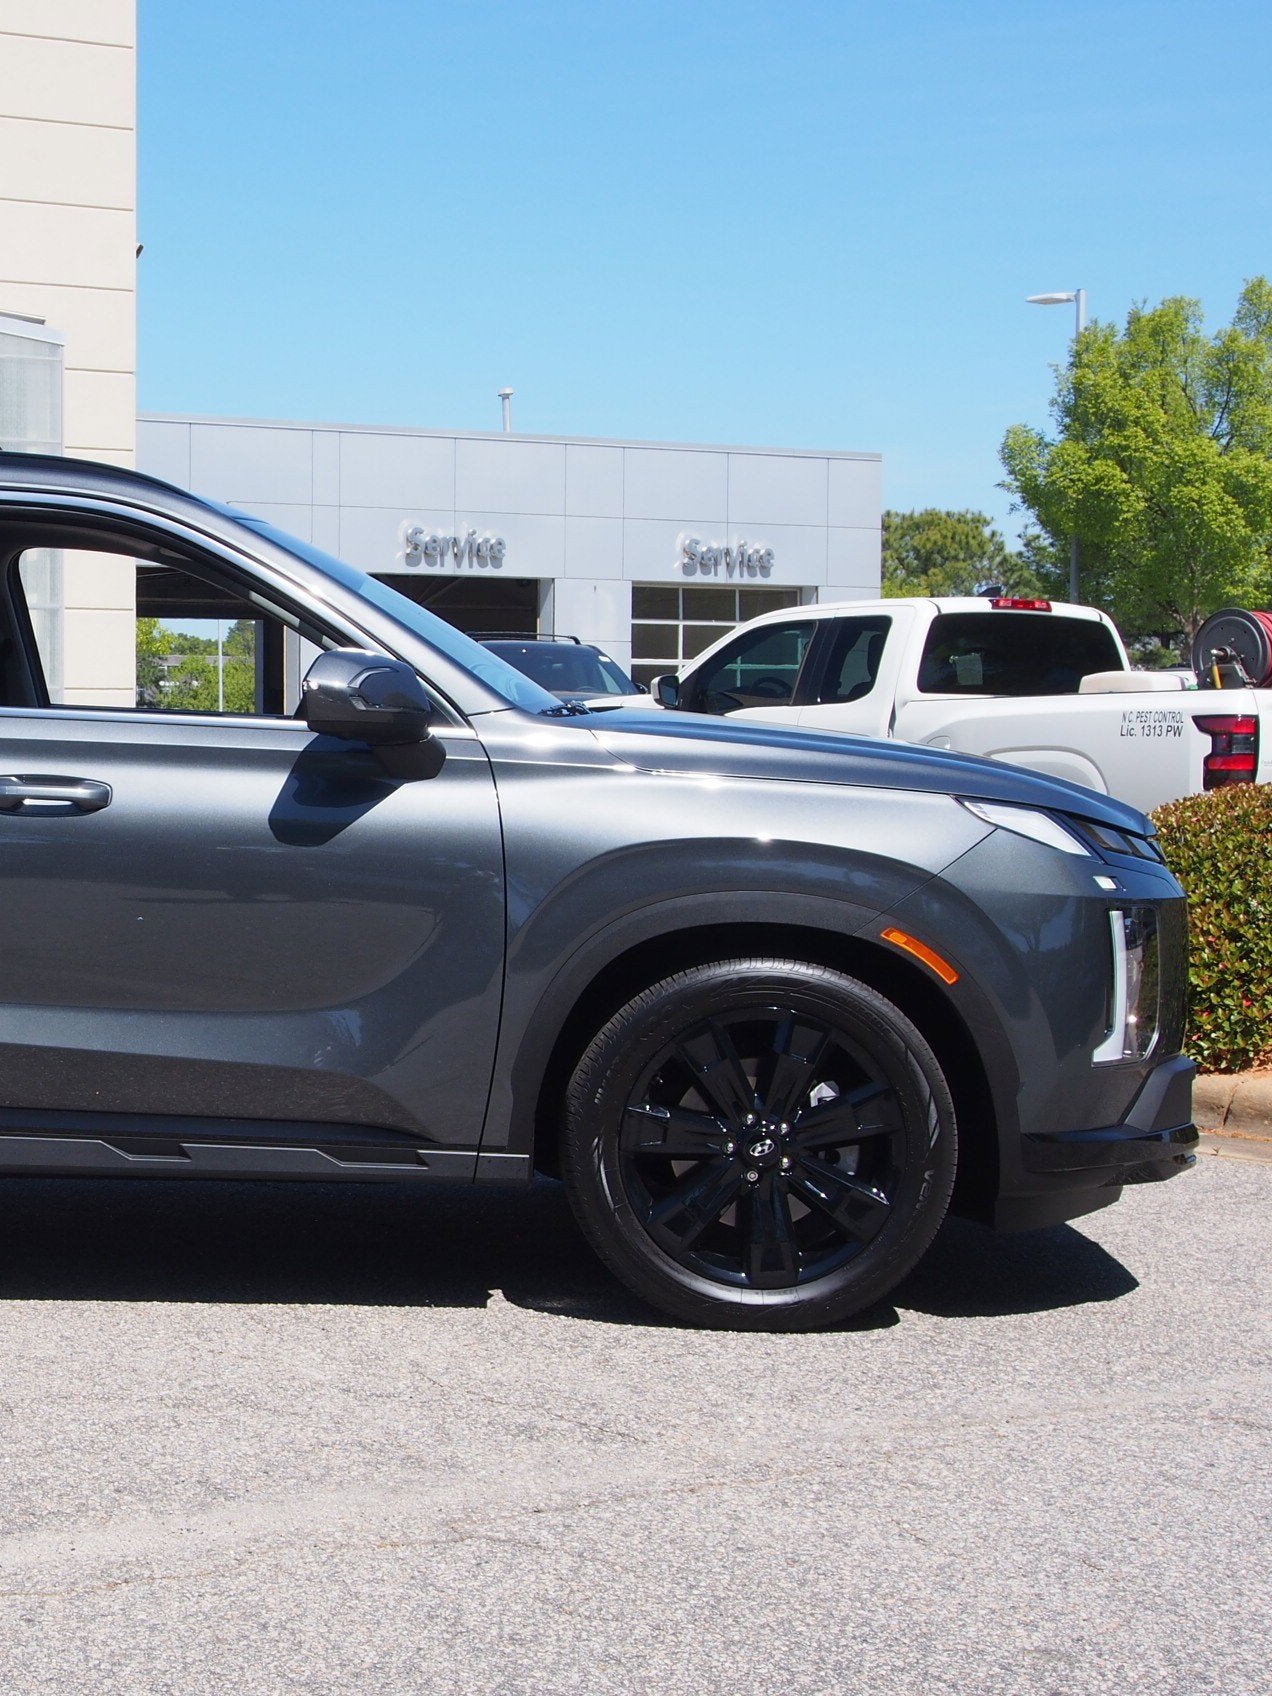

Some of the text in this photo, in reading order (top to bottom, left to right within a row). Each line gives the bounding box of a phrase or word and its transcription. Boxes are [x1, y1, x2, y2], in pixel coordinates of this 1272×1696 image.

[404, 526, 506, 564] Service
[681, 538, 775, 573] Service
[1136, 710, 1152, 723] PEST
[1153, 710, 1184, 724] CONTROL
[1119, 724, 1184, 738] Lic. 1313 PW
